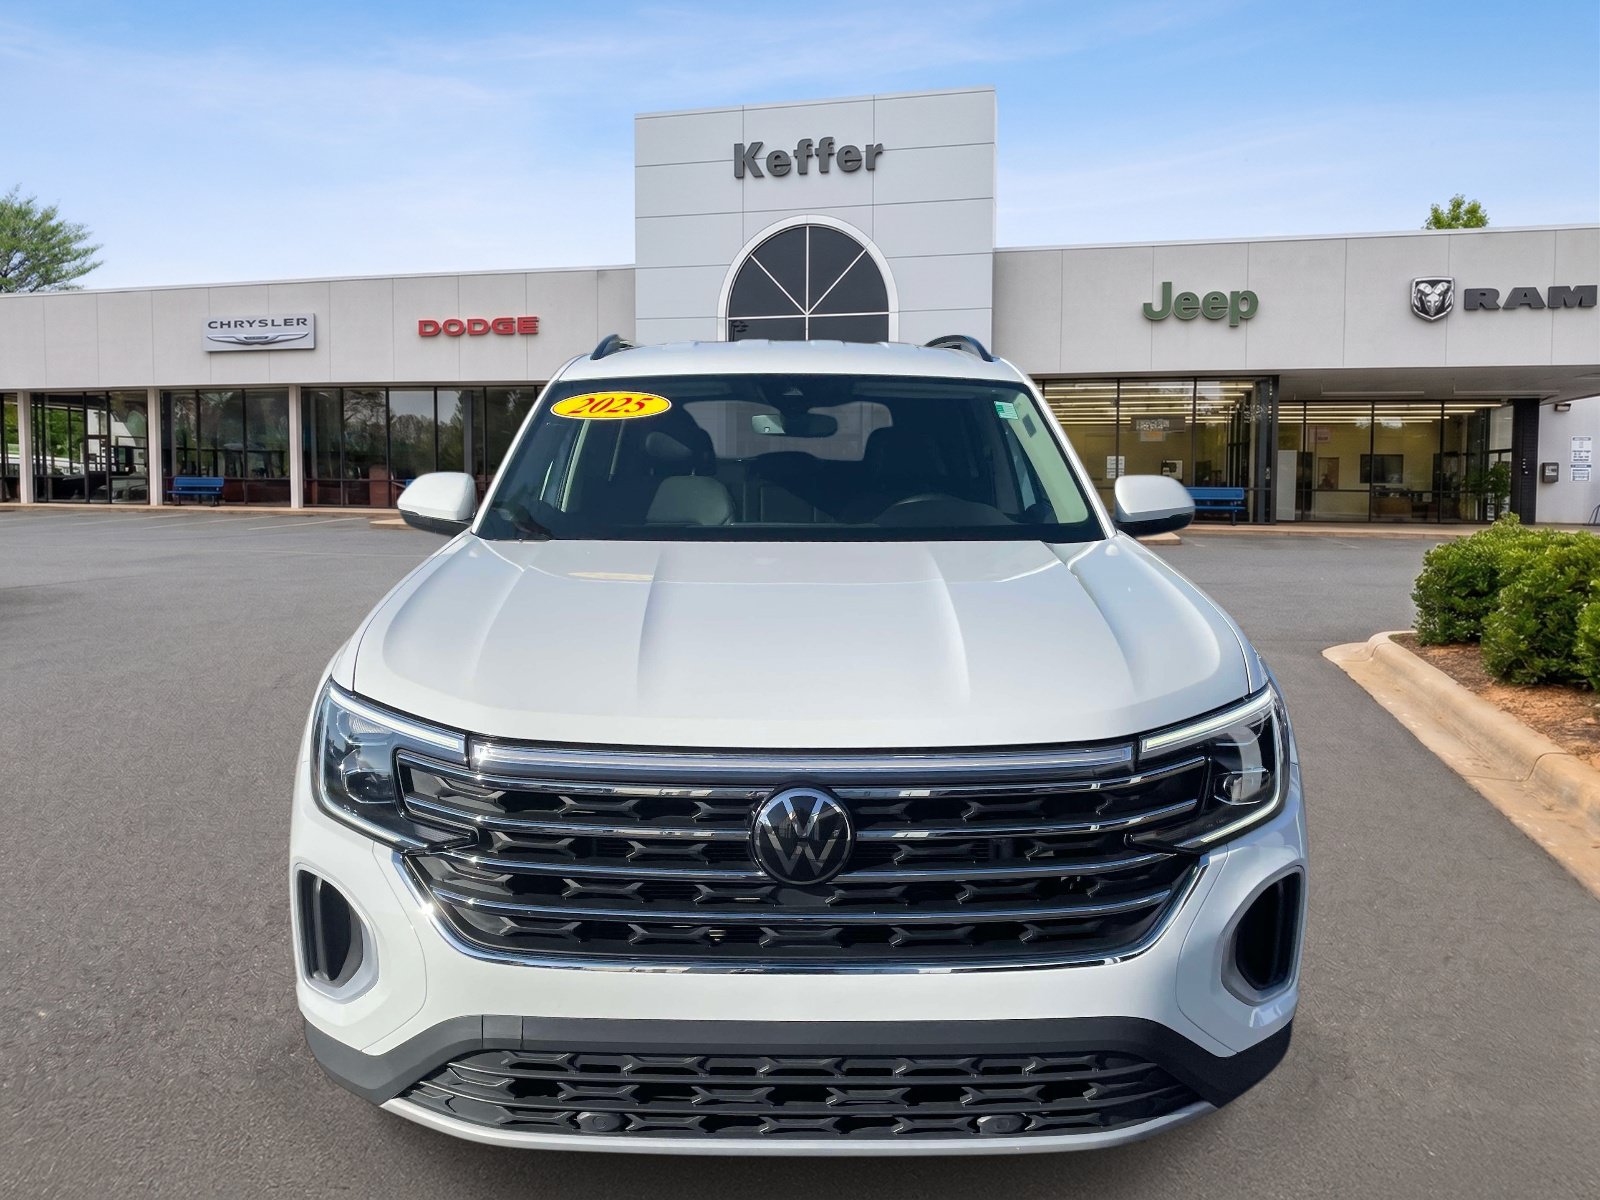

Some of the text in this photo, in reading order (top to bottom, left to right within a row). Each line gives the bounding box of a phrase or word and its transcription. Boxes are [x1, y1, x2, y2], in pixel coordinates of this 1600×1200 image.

[734, 137, 883, 178] Keffer
[1143, 282, 1259, 327] Jeep
[1464, 285, 1598, 310] RAM
[207, 318, 308, 329] CHRYSLER
[418, 317, 539, 336] DODGE
[567, 397, 655, 414] 2025
